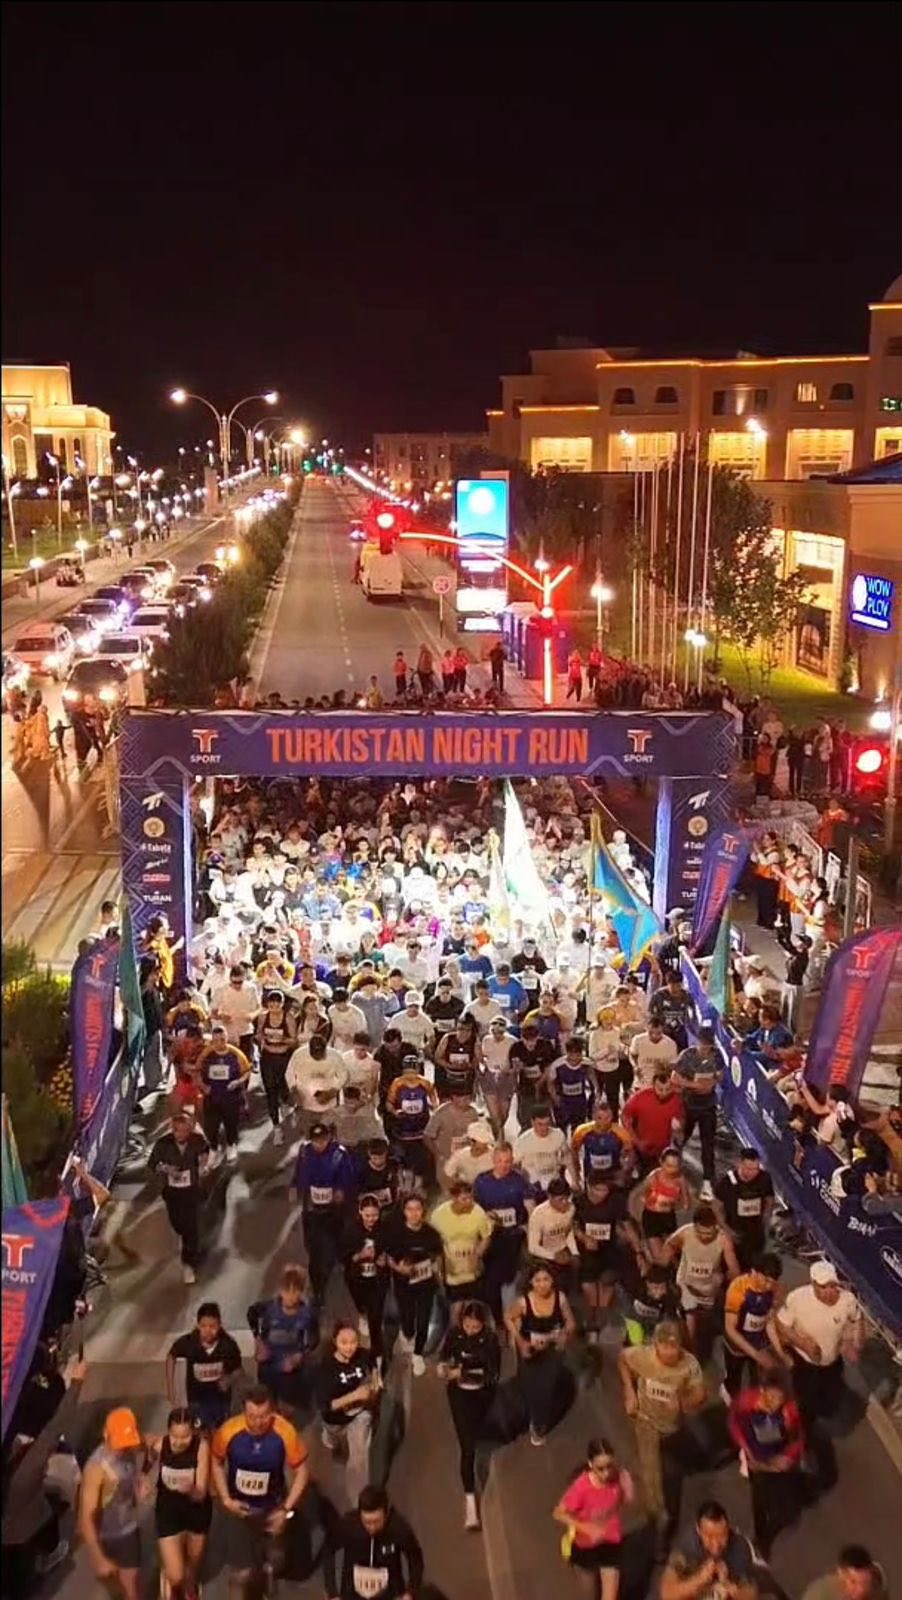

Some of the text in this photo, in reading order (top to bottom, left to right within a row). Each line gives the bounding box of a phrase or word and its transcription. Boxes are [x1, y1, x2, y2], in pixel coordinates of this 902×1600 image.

[867, 577, 891, 597] WOW
[867, 597, 890, 617] PLOV
[266, 728, 588, 764] TURKISTAN NIGHT RUN
[190, 755, 221, 764] SPORT
[624, 755, 654, 763] SPORT
[143, 894, 171, 902] TURAN
[2, 1269, 36, 1284] PORT
[241, 1480, 264, 1490] 1428
